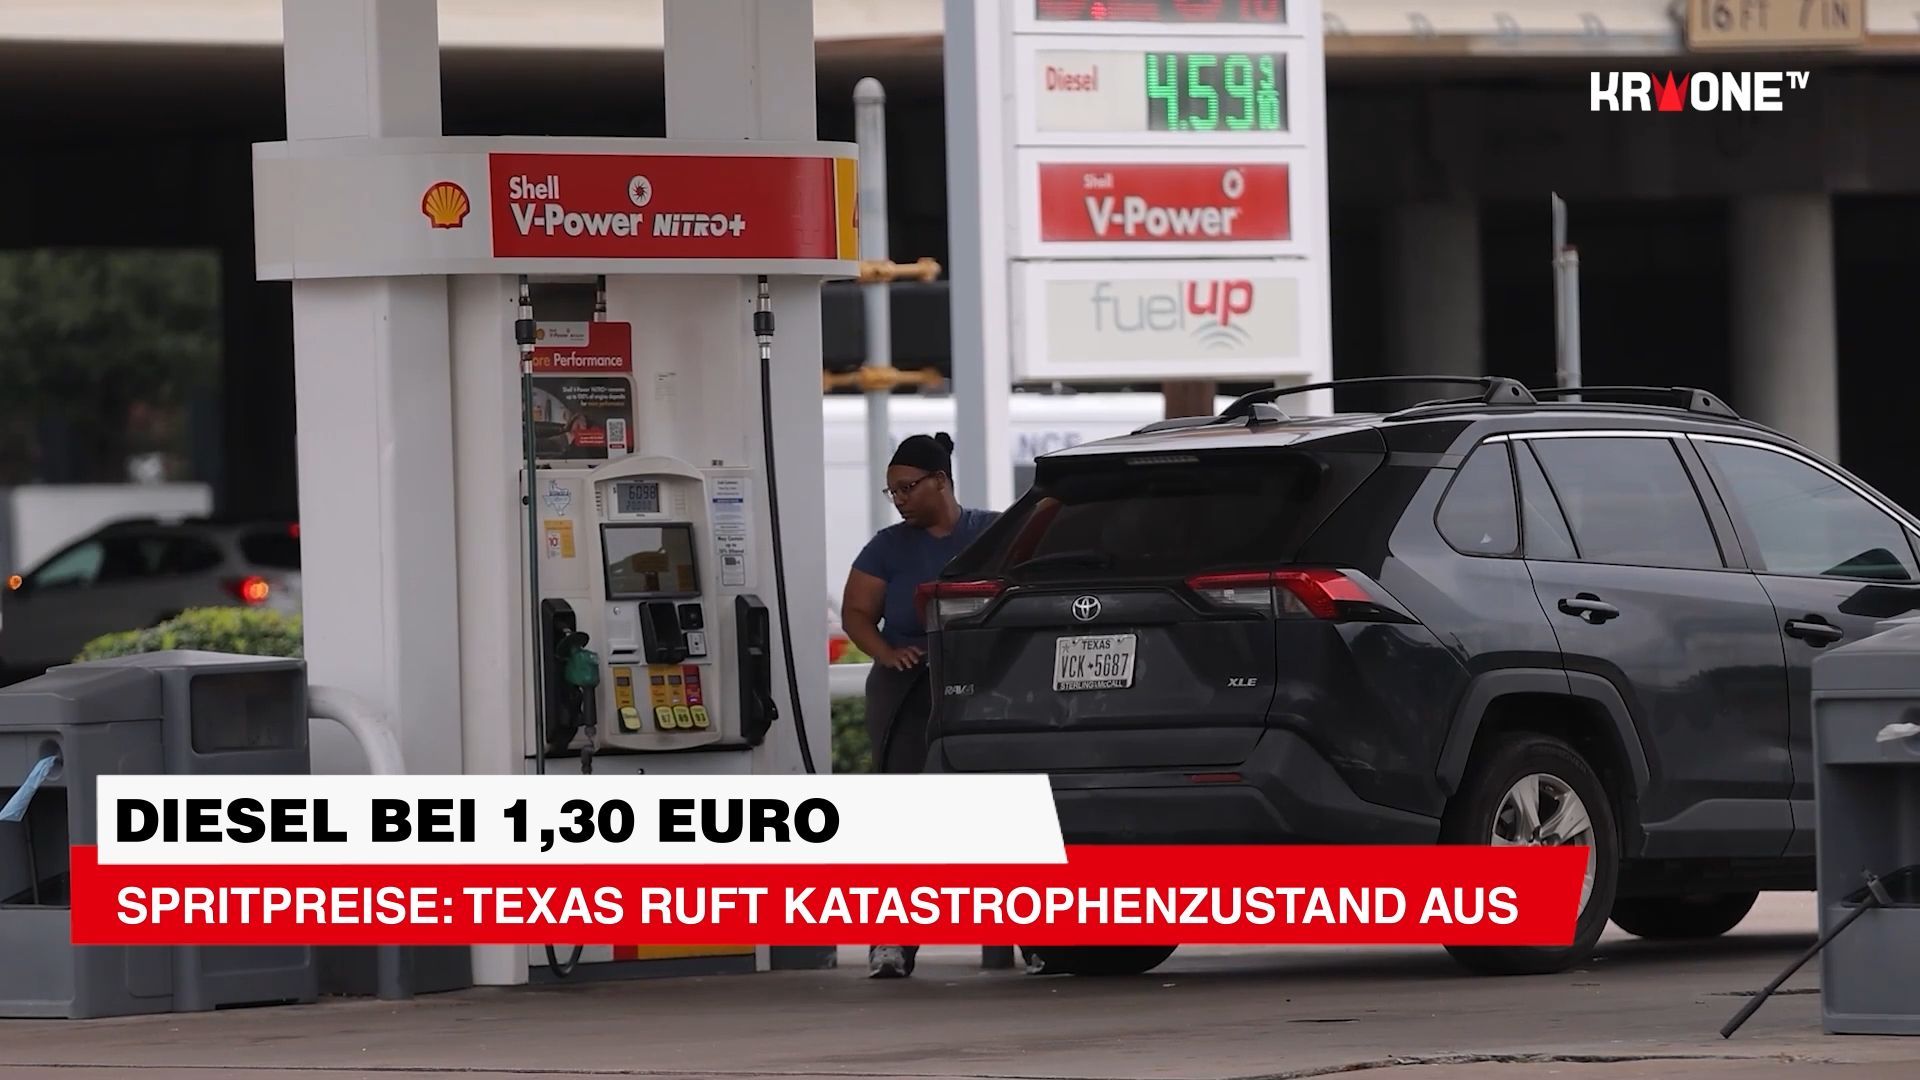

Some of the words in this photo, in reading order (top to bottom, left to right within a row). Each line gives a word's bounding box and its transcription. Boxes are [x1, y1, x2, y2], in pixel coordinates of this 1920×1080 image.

[1046, 65, 1099, 91] Diesel
[1146, 53, 1254, 131] 4.59
[509, 174, 560, 200] Shell
[1083, 172, 1115, 190] Shell
[510, 203, 644, 237] V-Power
[1084, 195, 1240, 236] V-Power
[533, 356, 551, 367] ore
[553, 350, 623, 367] Performance
[1082, 639, 1111, 651] TEXAS
[945, 684, 975, 696] RAV4
[1227, 676, 1258, 688] XLE
